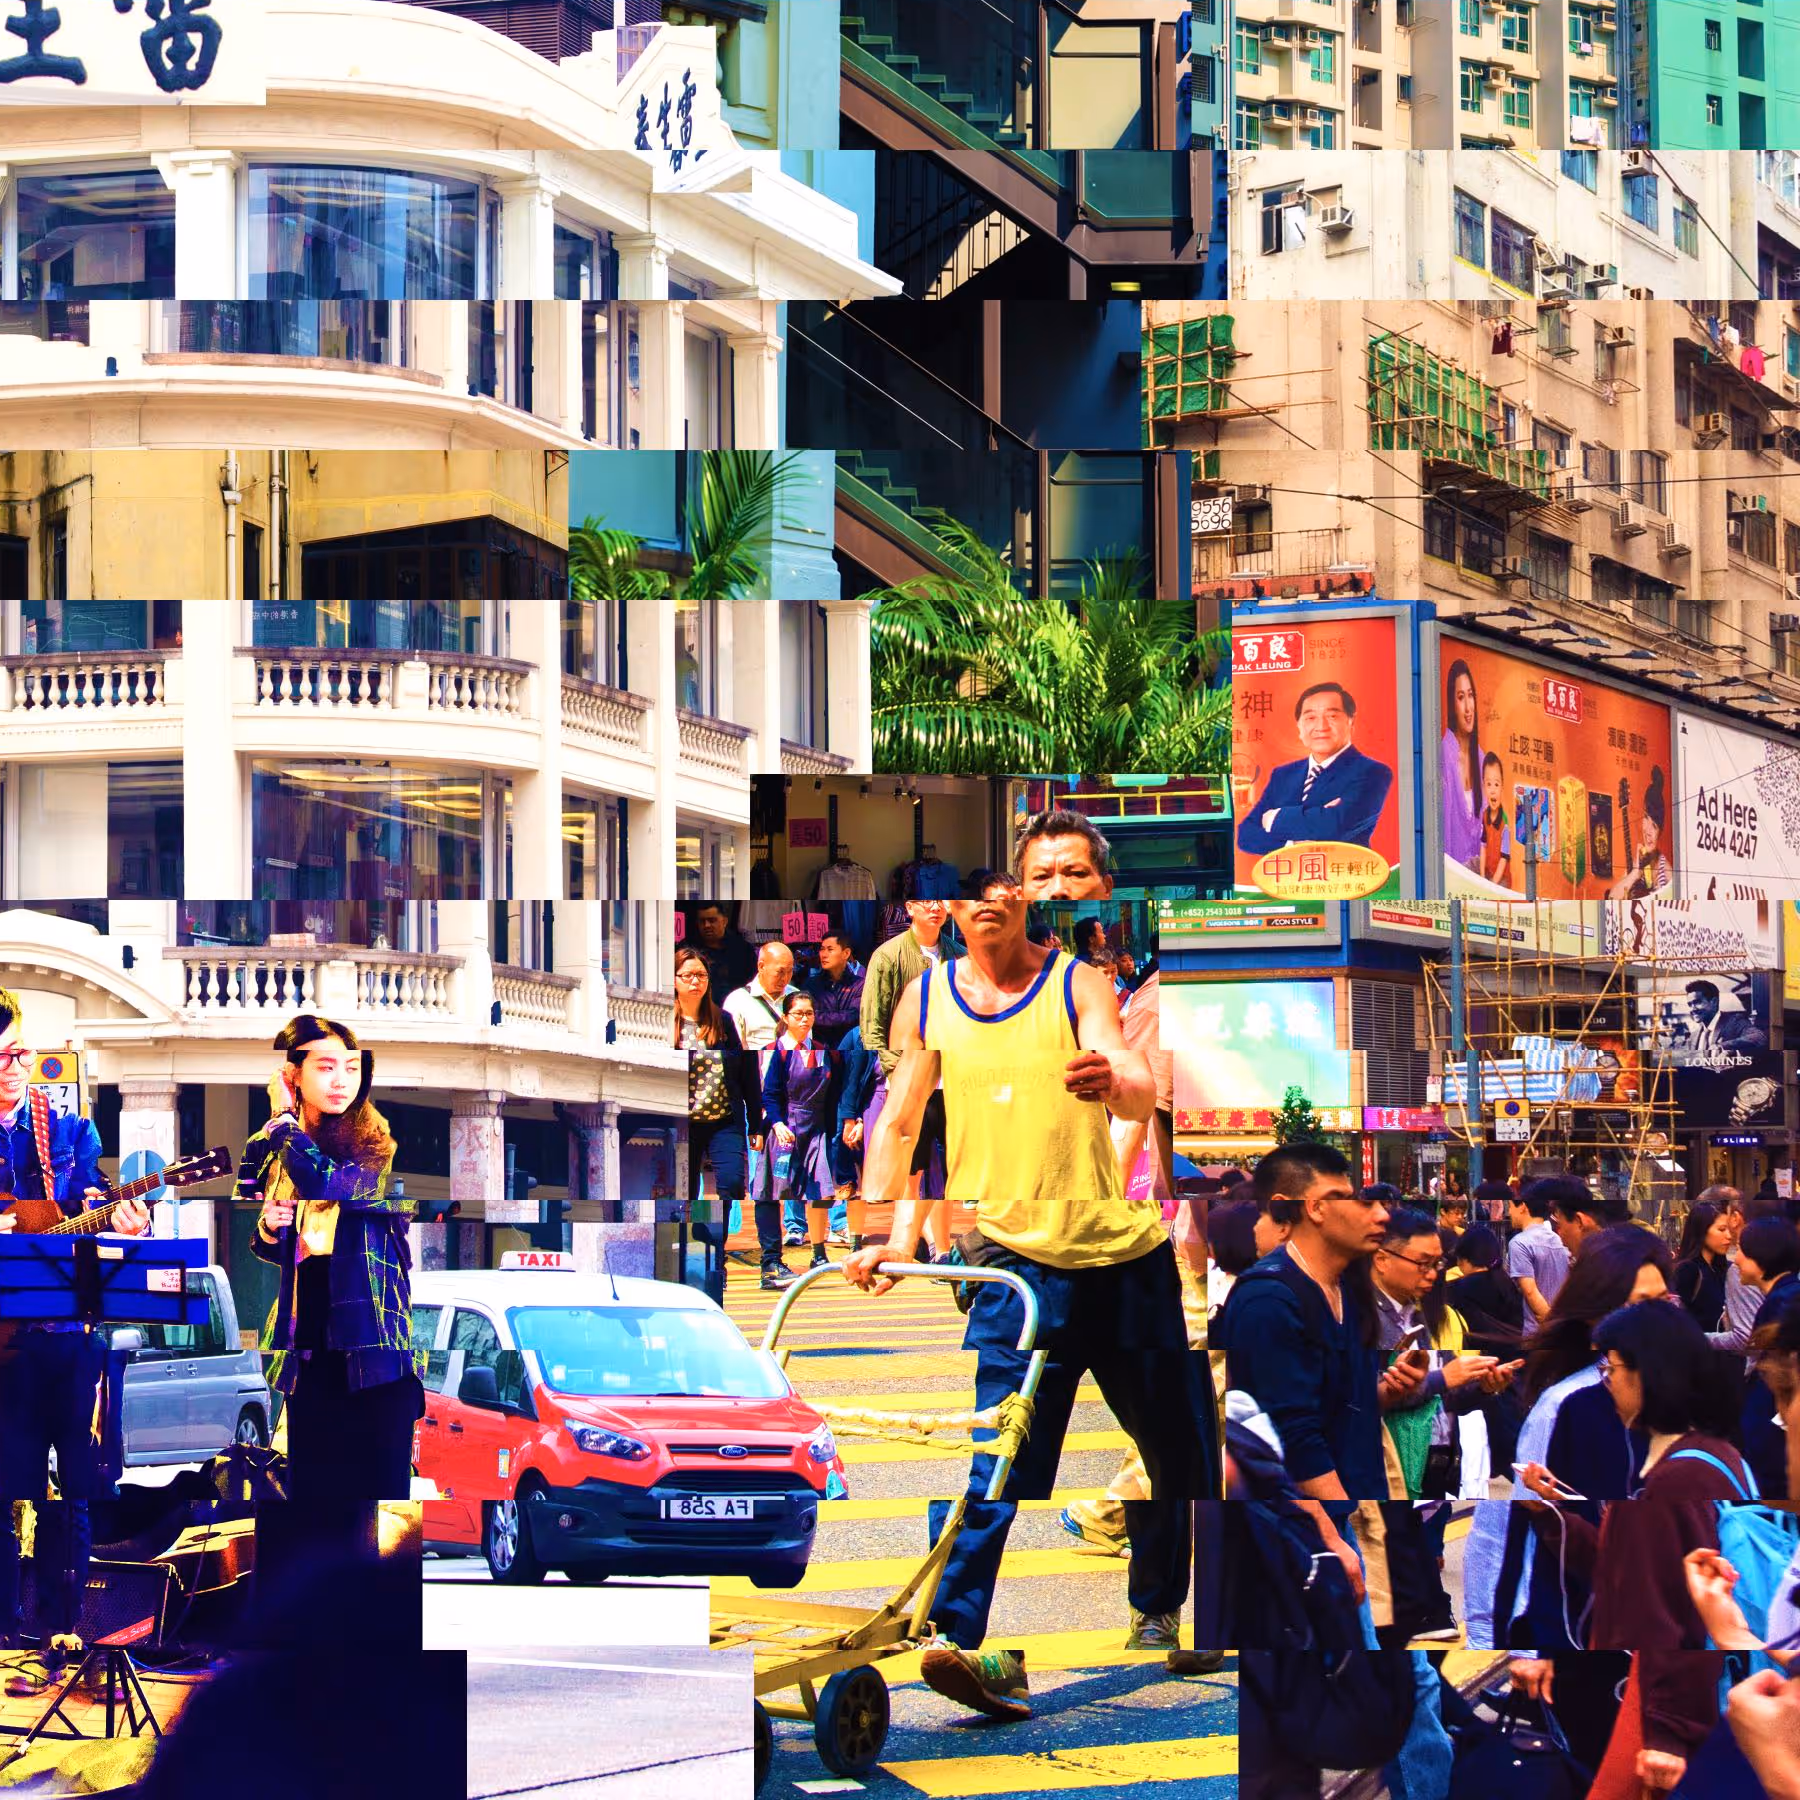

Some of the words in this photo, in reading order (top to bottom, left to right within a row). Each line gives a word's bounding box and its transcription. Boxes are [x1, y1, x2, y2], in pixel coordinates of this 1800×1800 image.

[1232, 635, 1292, 662] 百良
[1308, 637, 1347, 650] SINCE
[1255, 661, 1292, 671] LEUNG
[1697, 786, 1719, 822] Ad
[1723, 792, 1758, 832] Here
[1697, 821, 1727, 855] 2864
[1729, 829, 1758, 861] 4247
[788, 918, 801, 937] 50
[1684, 1055, 1753, 1068] LONGINES
[60, 1085, 69, 1098] 7
[1517, 1119, 1524, 1127] 7
[1517, 1132, 1529, 1140] 12
[516, 1253, 562, 1267] TAXI
